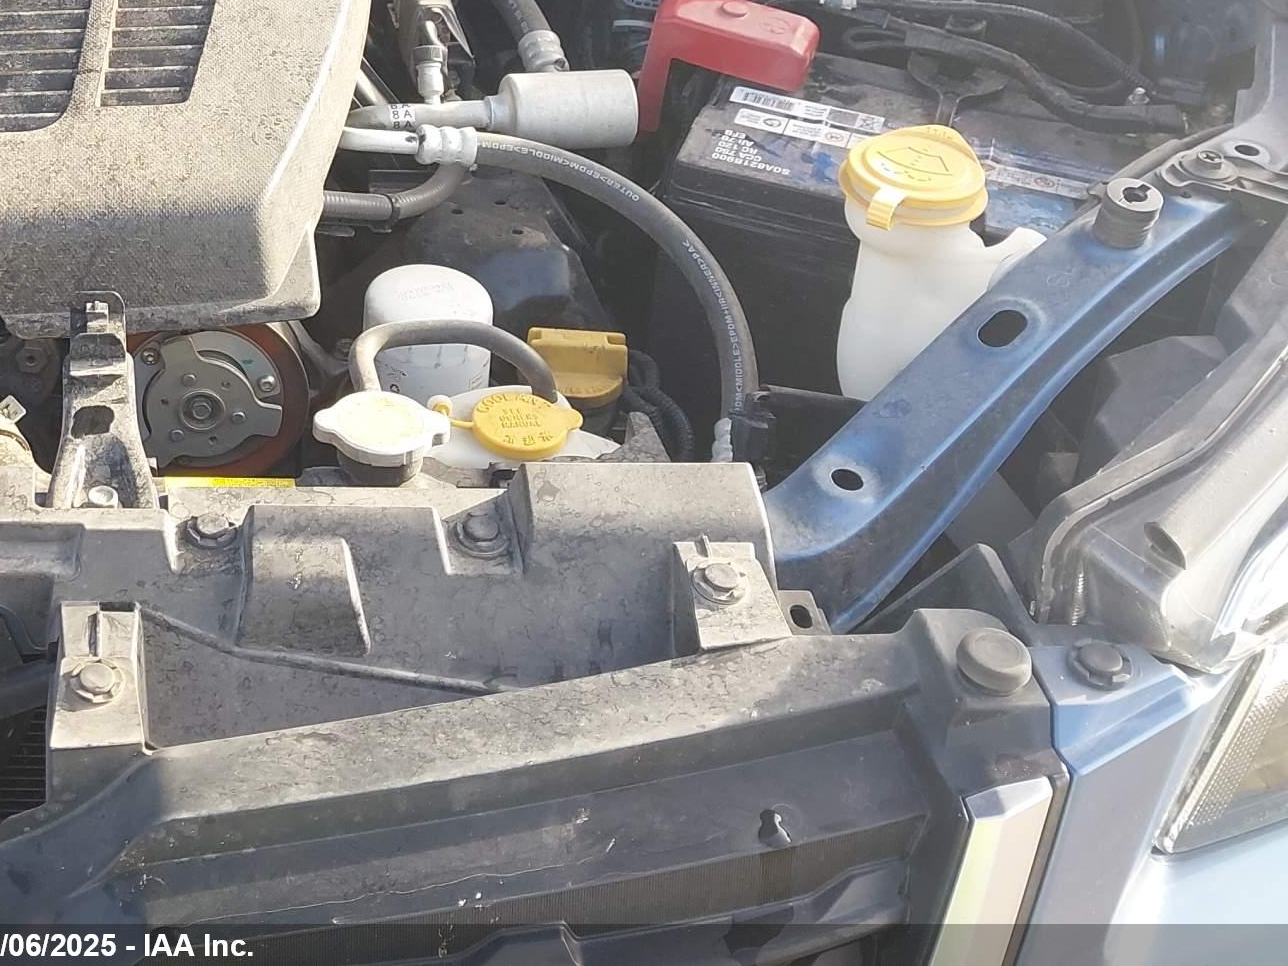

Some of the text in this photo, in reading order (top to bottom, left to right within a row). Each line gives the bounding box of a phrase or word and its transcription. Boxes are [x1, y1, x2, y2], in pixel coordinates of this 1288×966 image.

[392, 110, 412, 119] 8 A
[715, 146, 762, 162] CCA 750
[718, 141, 758, 155] RC 120
